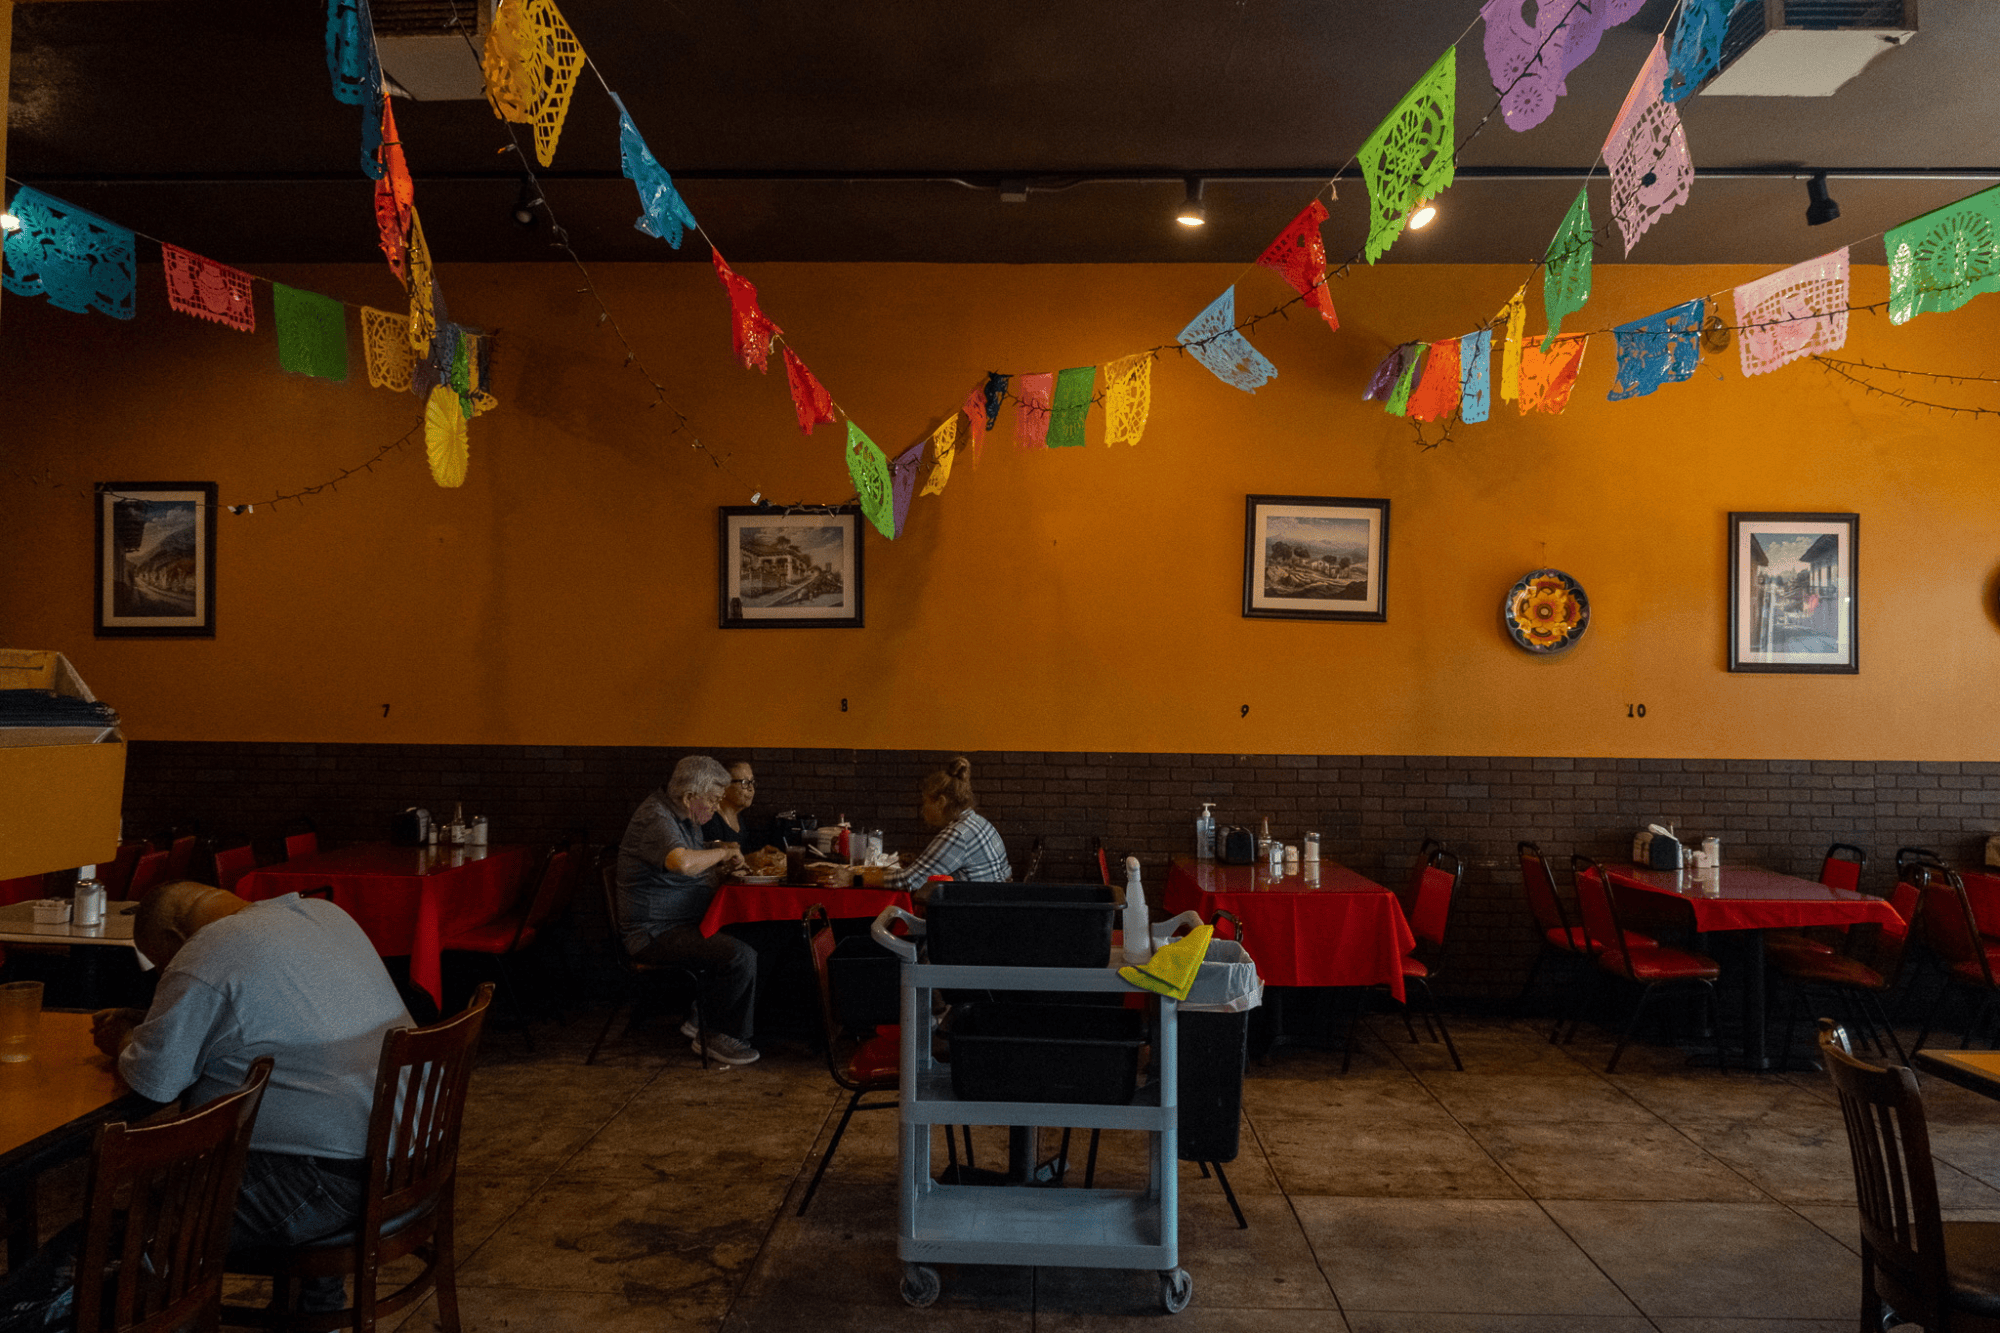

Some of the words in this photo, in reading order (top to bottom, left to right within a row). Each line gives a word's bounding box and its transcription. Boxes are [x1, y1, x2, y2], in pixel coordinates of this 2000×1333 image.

[381, 703, 391, 719] 7
[841, 697, 849, 713] 8
[1240, 704, 1250, 719] 9
[1627, 703, 1647, 718] 10
